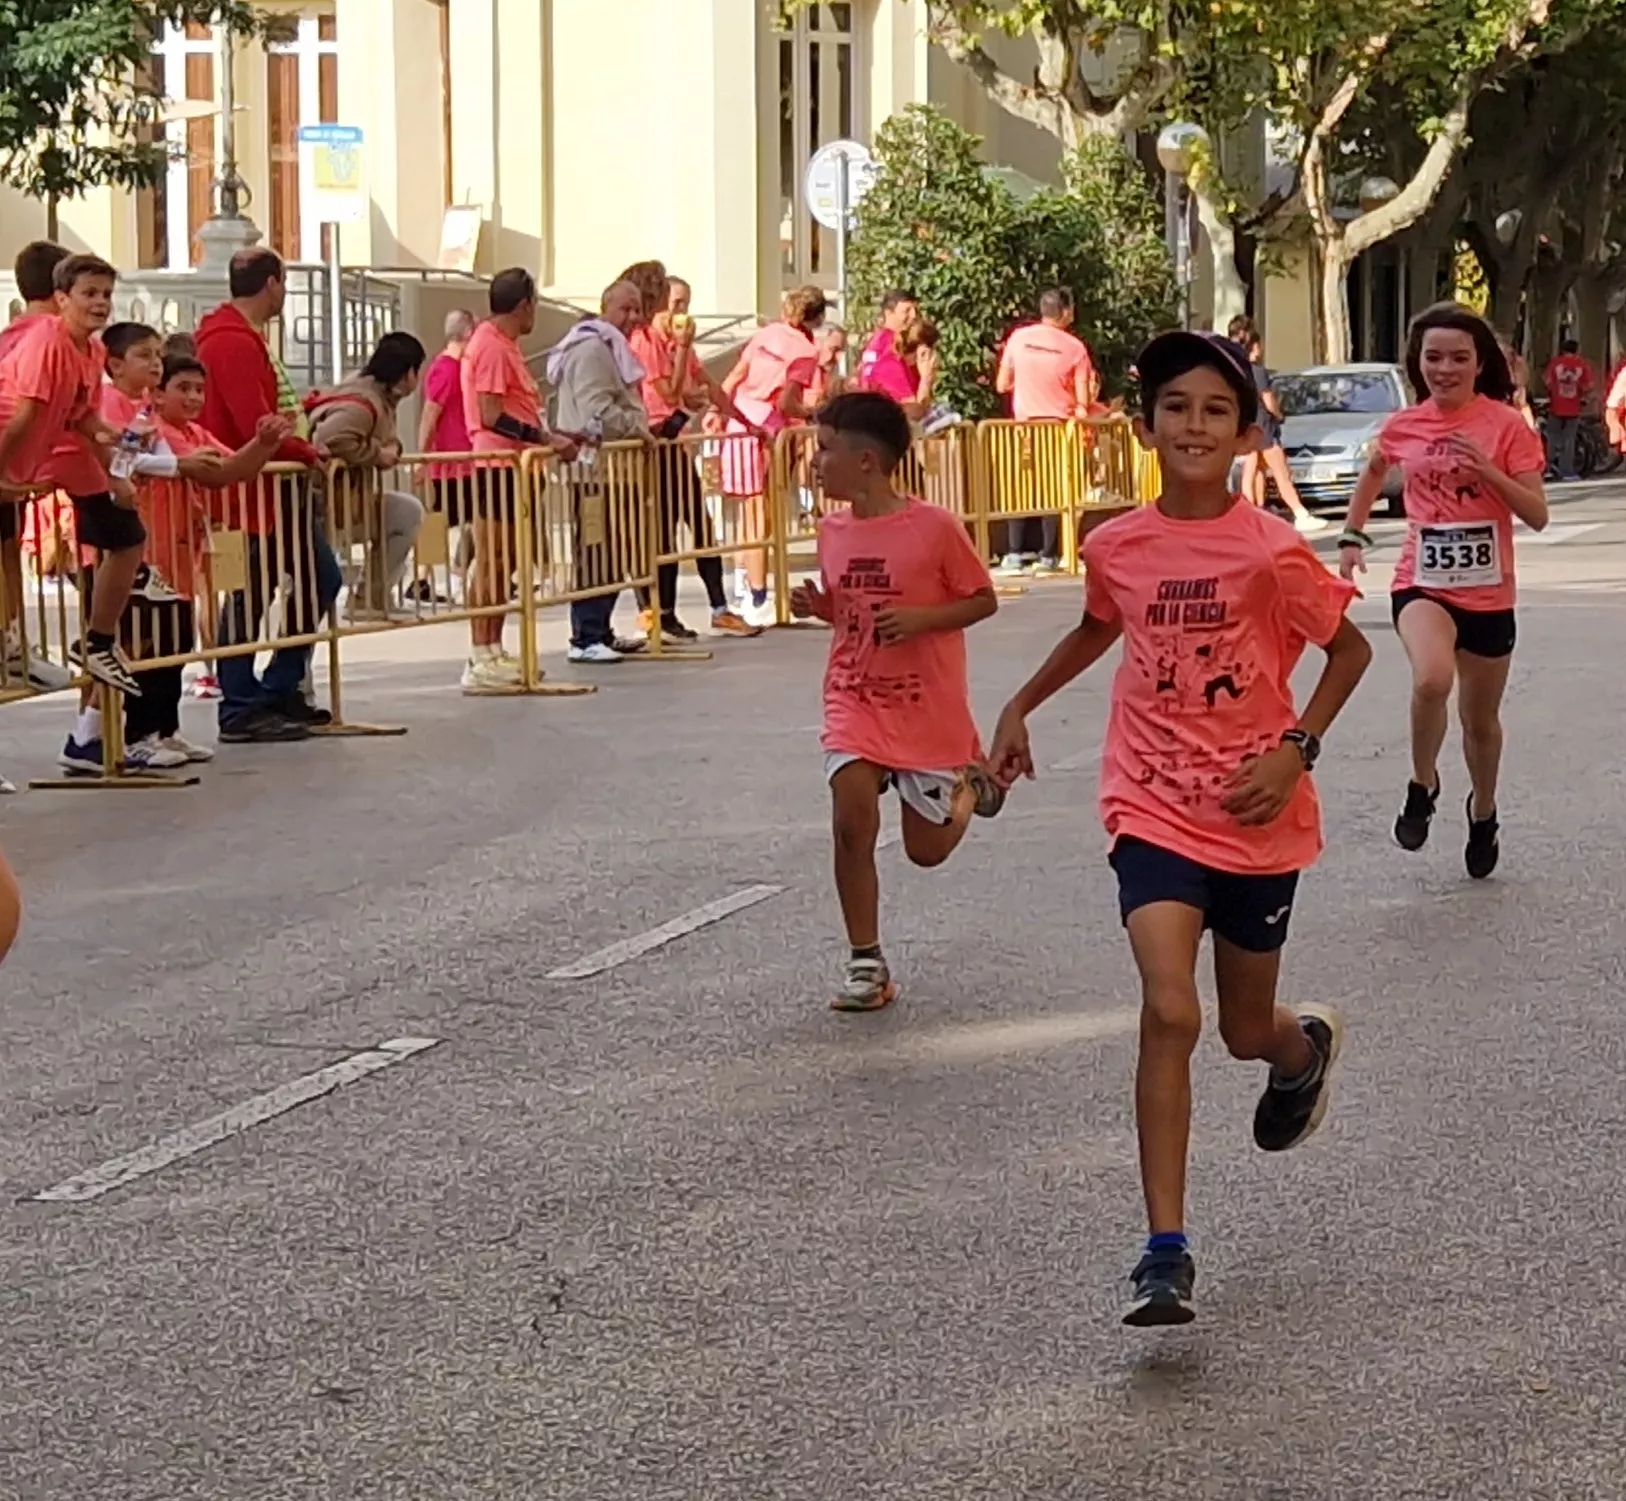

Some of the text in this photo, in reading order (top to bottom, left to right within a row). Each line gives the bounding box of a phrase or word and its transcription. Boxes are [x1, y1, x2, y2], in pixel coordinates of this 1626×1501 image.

[1423, 543, 1491, 569] 3538
[1157, 576, 1219, 601] CORRAMOS
[1144, 600, 1227, 626] POR LA CIENCIA
